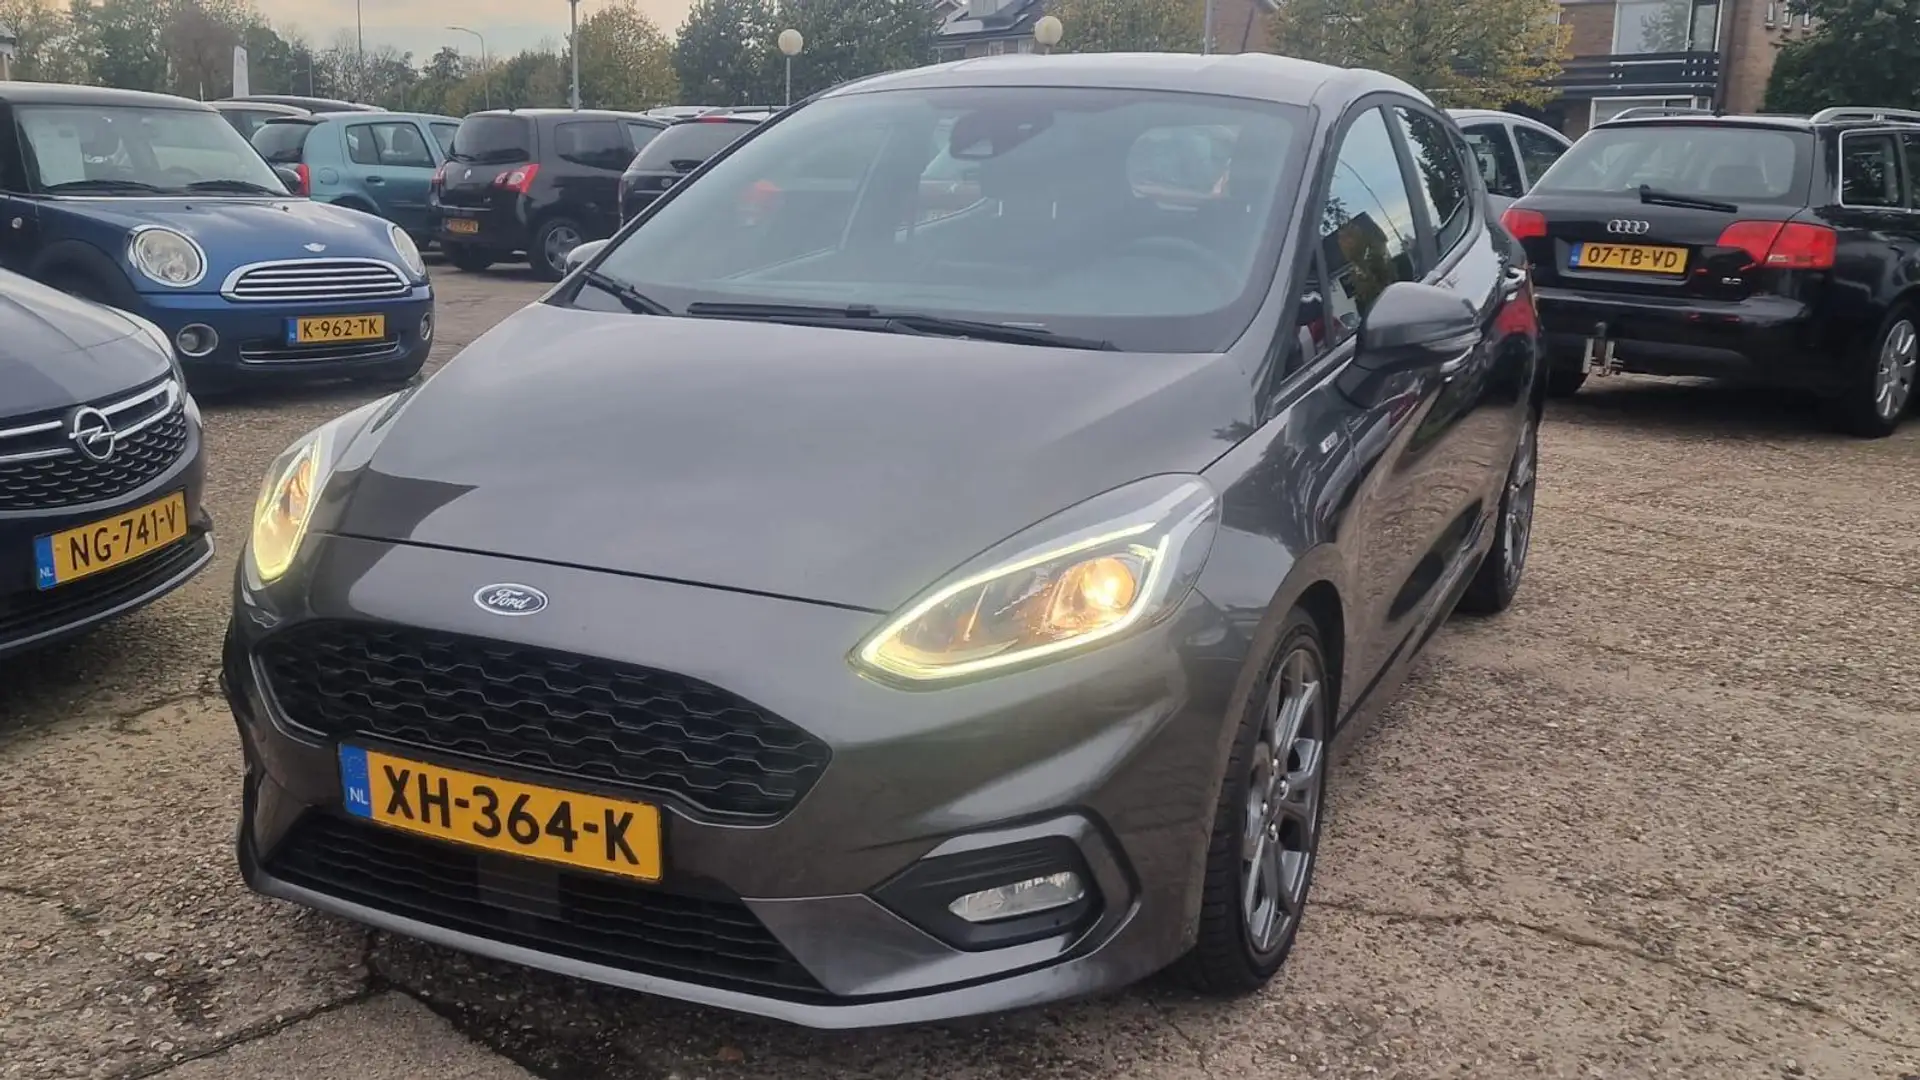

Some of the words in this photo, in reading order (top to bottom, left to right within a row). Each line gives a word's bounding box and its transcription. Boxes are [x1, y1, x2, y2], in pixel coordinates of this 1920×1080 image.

[1588, 246, 1678, 268] 07-TB-VD
[303, 318, 379, 338] K-962-TK
[70, 500, 176, 571] NG-741-V
[488, 588, 532, 609] Ford
[350, 787, 368, 805] NL
[383, 764, 640, 865] XH-364-K
